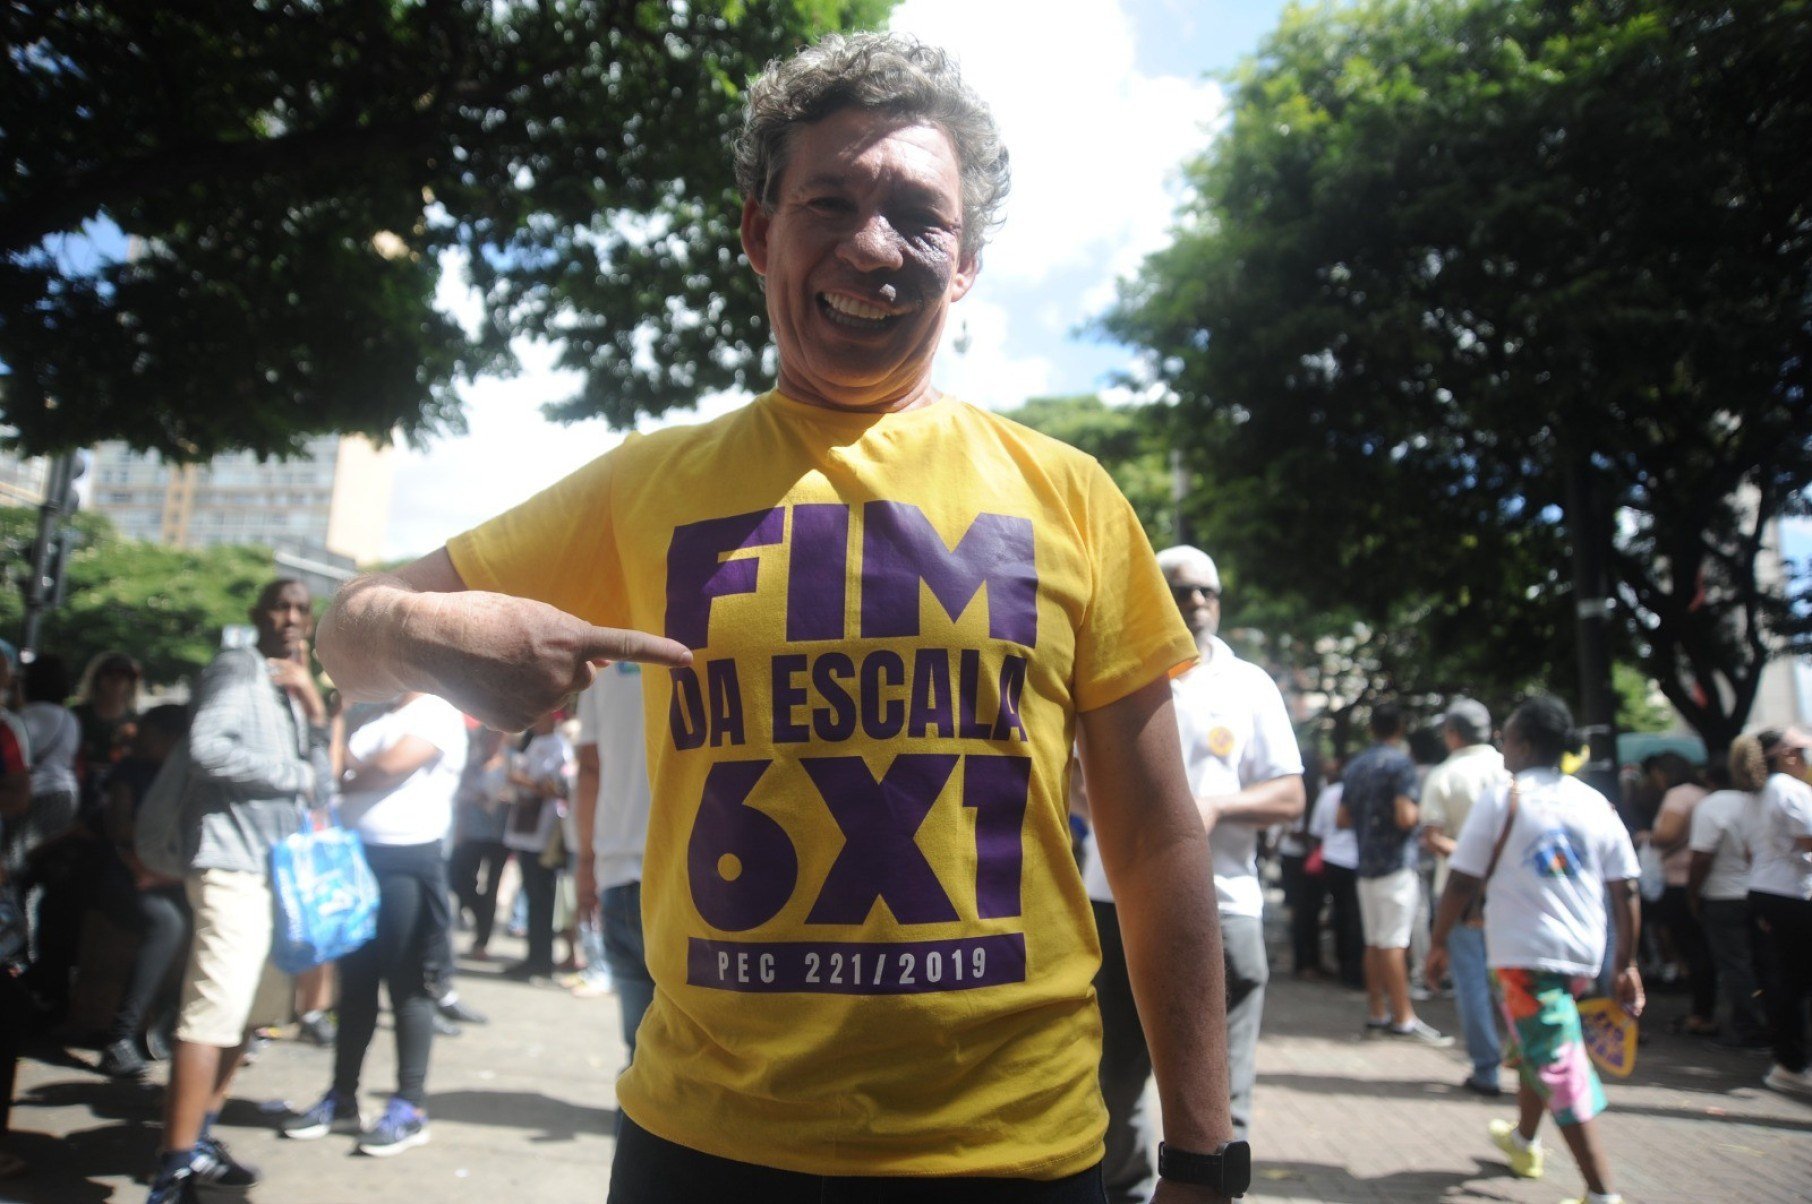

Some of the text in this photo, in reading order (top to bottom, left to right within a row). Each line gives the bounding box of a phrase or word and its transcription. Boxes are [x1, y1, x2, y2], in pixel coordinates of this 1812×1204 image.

[665, 501, 1037, 649] FIM
[669, 648, 1028, 751] DA ESCALA
[687, 754, 1032, 931] 6X1
[718, 948, 986, 985] PEC 221/2019
